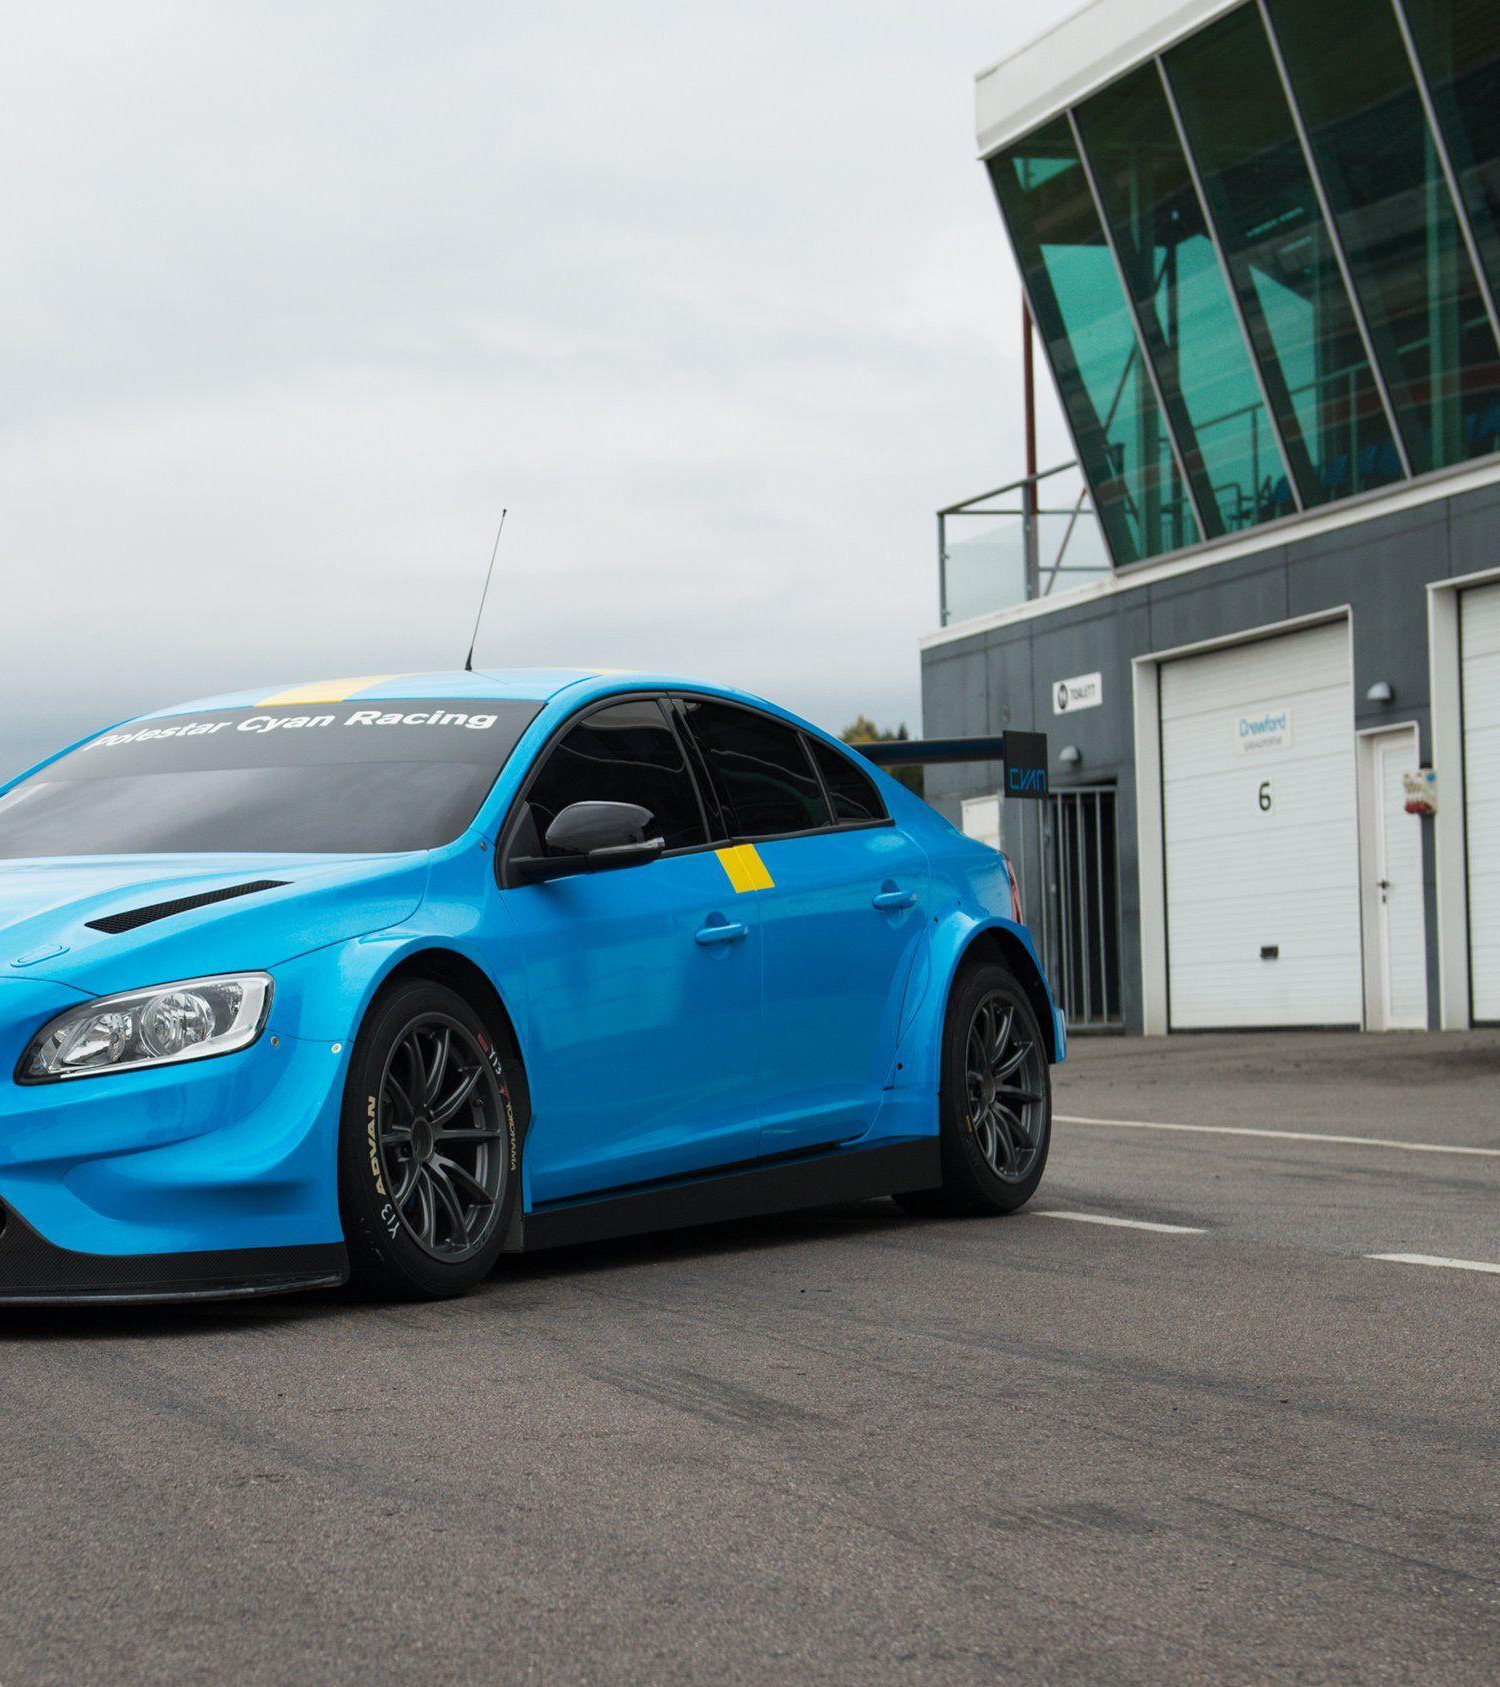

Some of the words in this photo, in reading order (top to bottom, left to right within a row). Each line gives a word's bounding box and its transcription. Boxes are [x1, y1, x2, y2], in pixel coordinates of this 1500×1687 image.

[82, 721, 233, 751] Polestar
[237, 715, 337, 733] Cyan
[343, 710, 498, 730] Racing
[1259, 781, 1271, 811] 6
[367, 1096, 387, 1196] ADVAN
[506, 1101, 516, 1171] YOKOHAMA
